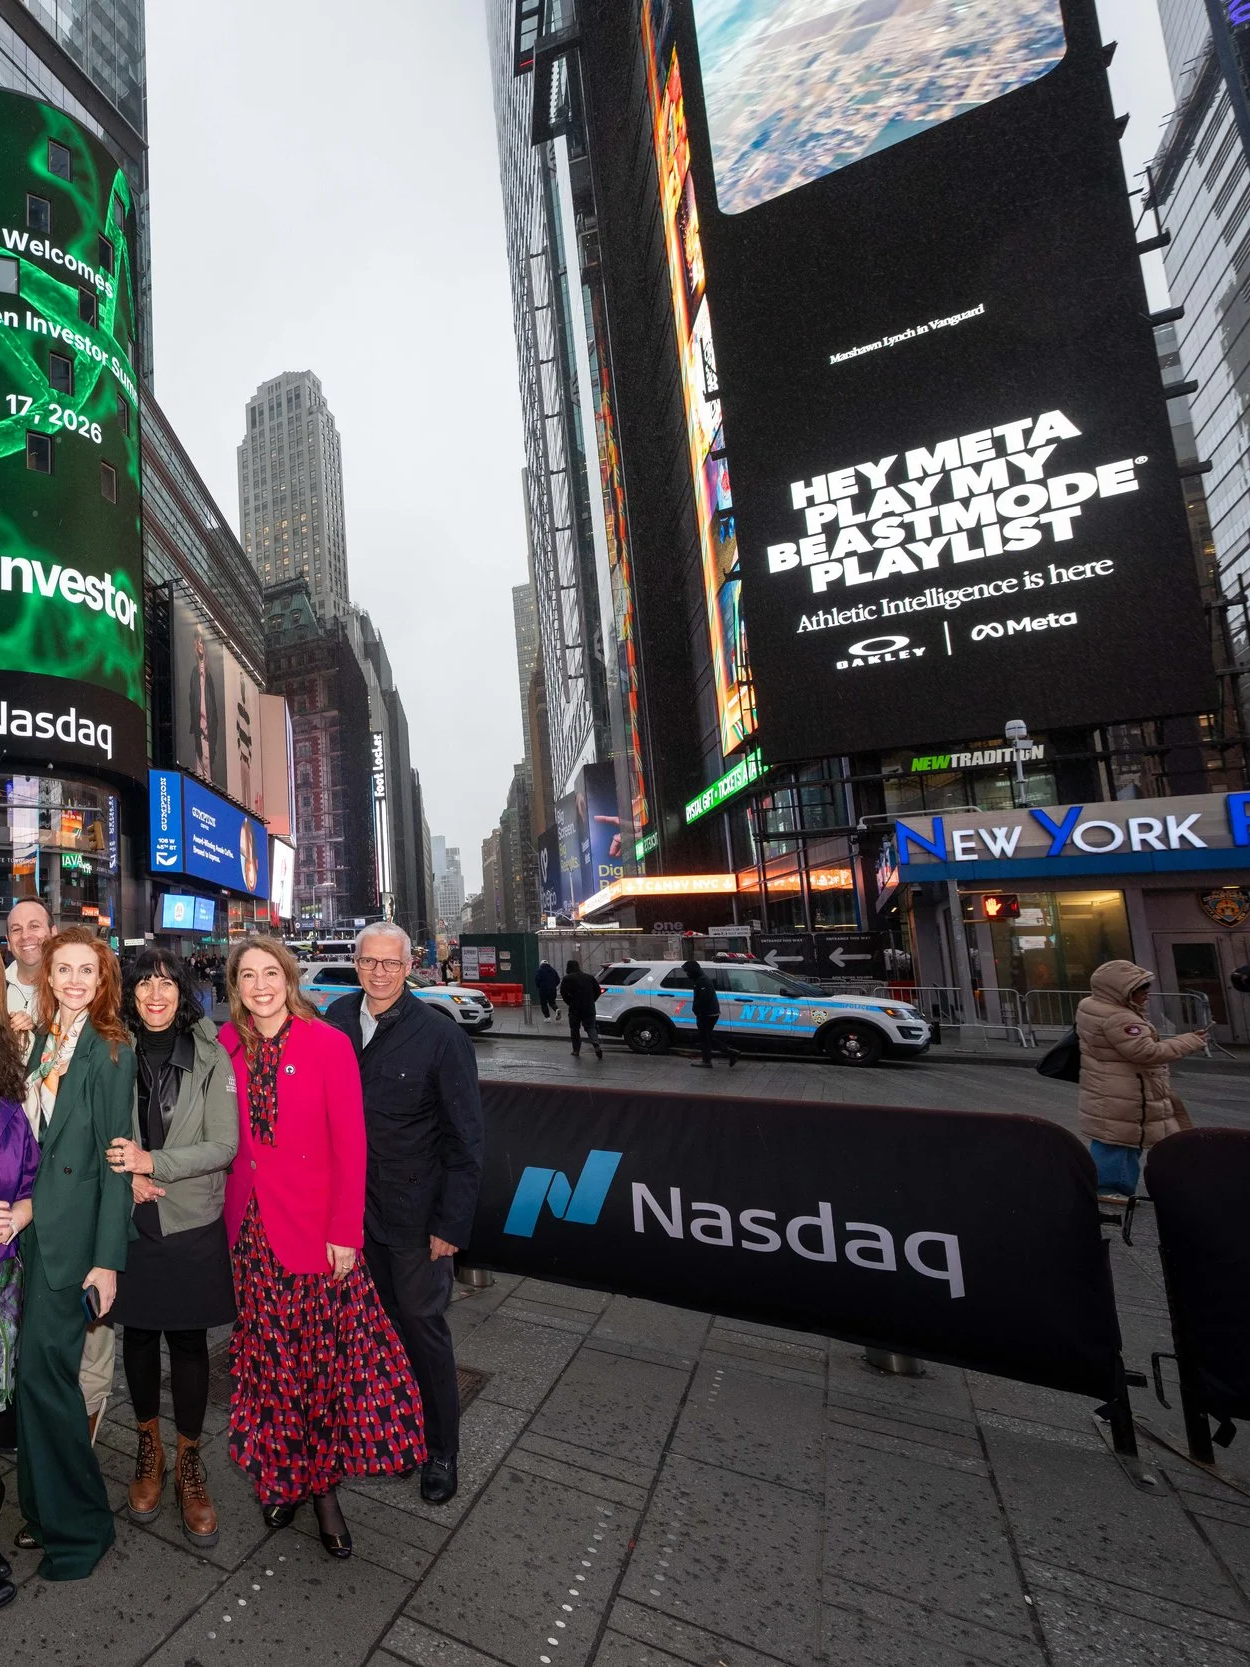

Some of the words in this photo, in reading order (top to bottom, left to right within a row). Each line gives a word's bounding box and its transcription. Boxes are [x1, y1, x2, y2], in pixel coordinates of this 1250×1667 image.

[2, 228, 113, 300] Welcomes
[26, 310, 109, 367] Investor
[882, 328, 916, 347] Lynch
[916, 325, 929, 336] in
[928, 302, 985, 331] Vanguard
[6, 393, 42, 425] 17,
[48, 402, 103, 445] 2026
[790, 455, 898, 510] HEY
[906, 409, 1082, 478] META
[805, 476, 950, 536] PLAY
[953, 444, 1057, 506] MY
[810, 505, 1082, 594] PLAYLIST
[796, 601, 877, 634] Athletic
[879, 572, 1019, 618] Intelligence
[1022, 570, 1046, 591] is
[1048, 555, 1115, 583] here
[836, 646, 926, 670] OAKLEY
[1006, 610, 1078, 636] Meta
[372, 733, 383, 771] Locker
[374, 775, 385, 797] Foot
[895, 817, 1022, 866] NEW
[1029, 806, 1209, 857] YORK
[653, 922, 684, 931] one
[739, 1004, 801, 1024] NYPD
[631, 1182, 966, 1298] Nasdaq
